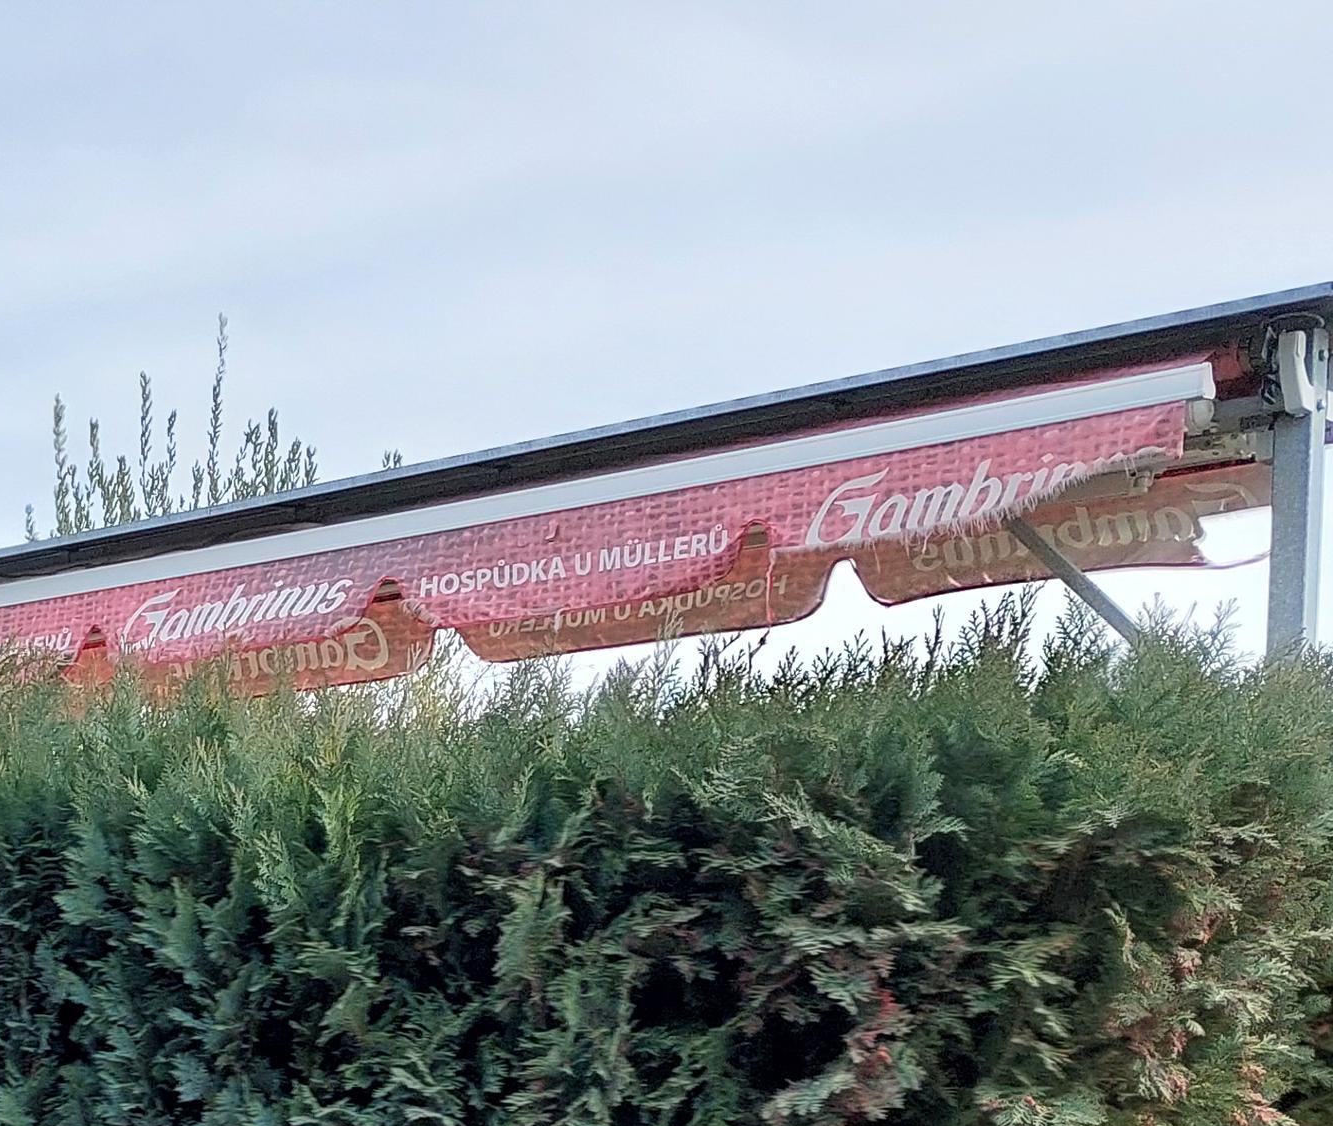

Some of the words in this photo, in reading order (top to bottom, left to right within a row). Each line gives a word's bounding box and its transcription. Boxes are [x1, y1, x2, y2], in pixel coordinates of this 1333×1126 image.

[419, 560, 566, 598] HOSPŮDKA
[575, 553, 592, 576] U
[598, 523, 729, 572] MÜLLERŮ
[119, 579, 354, 654] Gambrinus
